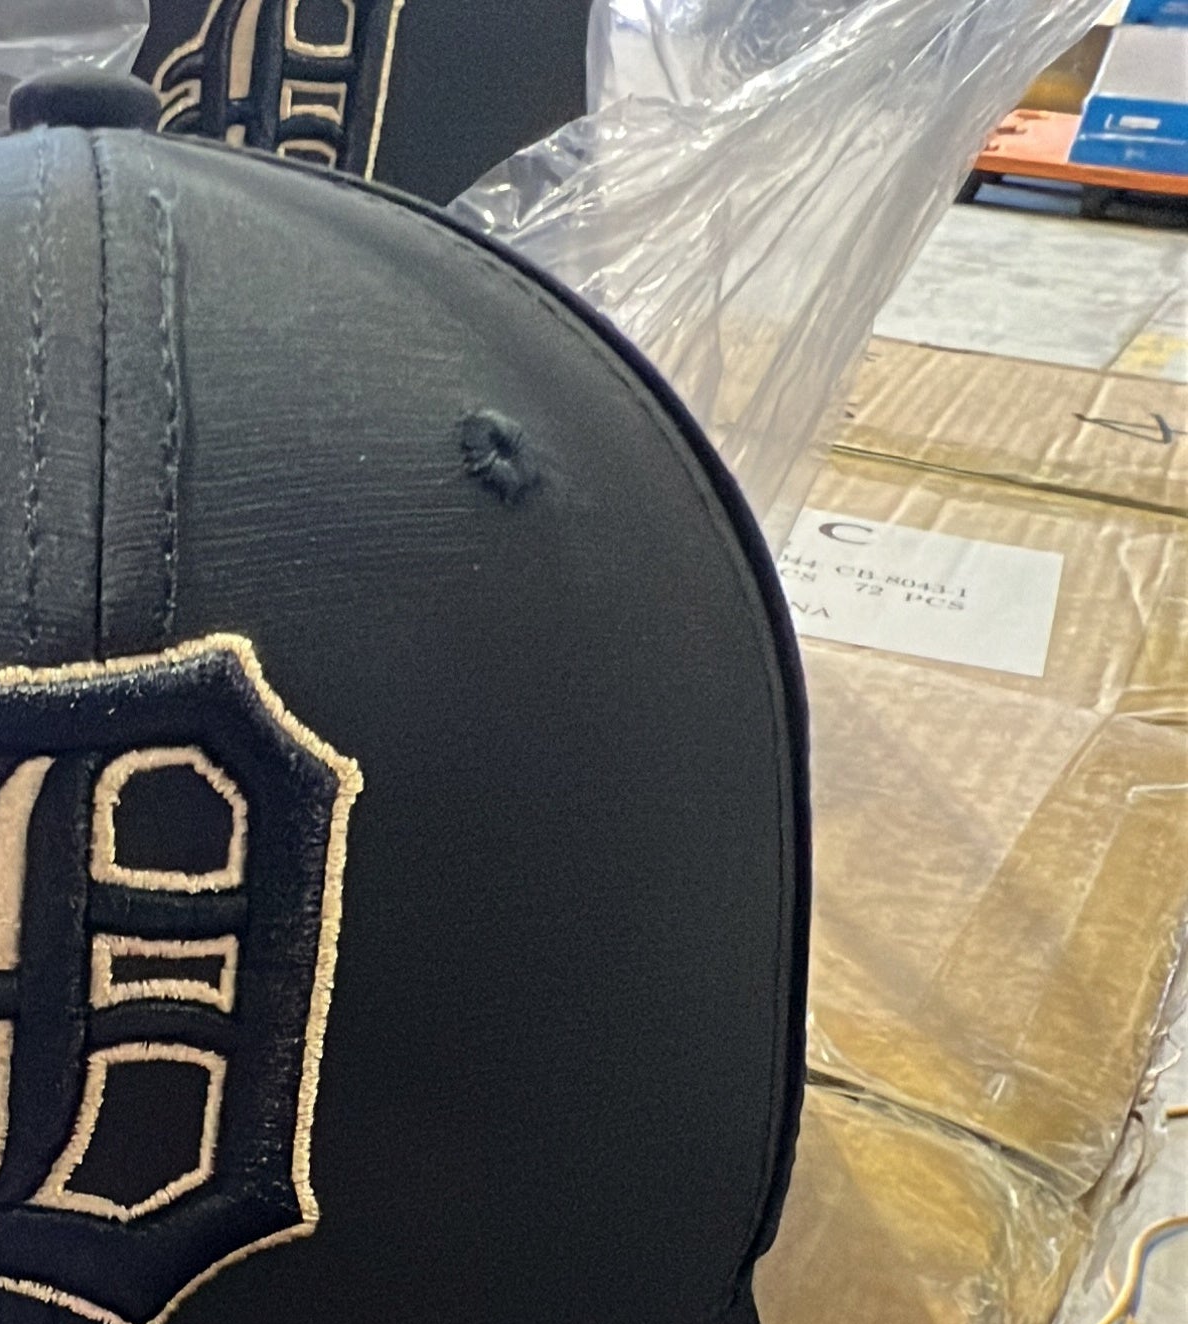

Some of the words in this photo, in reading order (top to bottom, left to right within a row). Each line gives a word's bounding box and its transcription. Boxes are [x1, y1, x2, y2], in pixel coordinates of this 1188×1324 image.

[818, 521, 875, 546] C
[854, 581, 884, 597] 72
[905, 592, 966, 611] PCS
